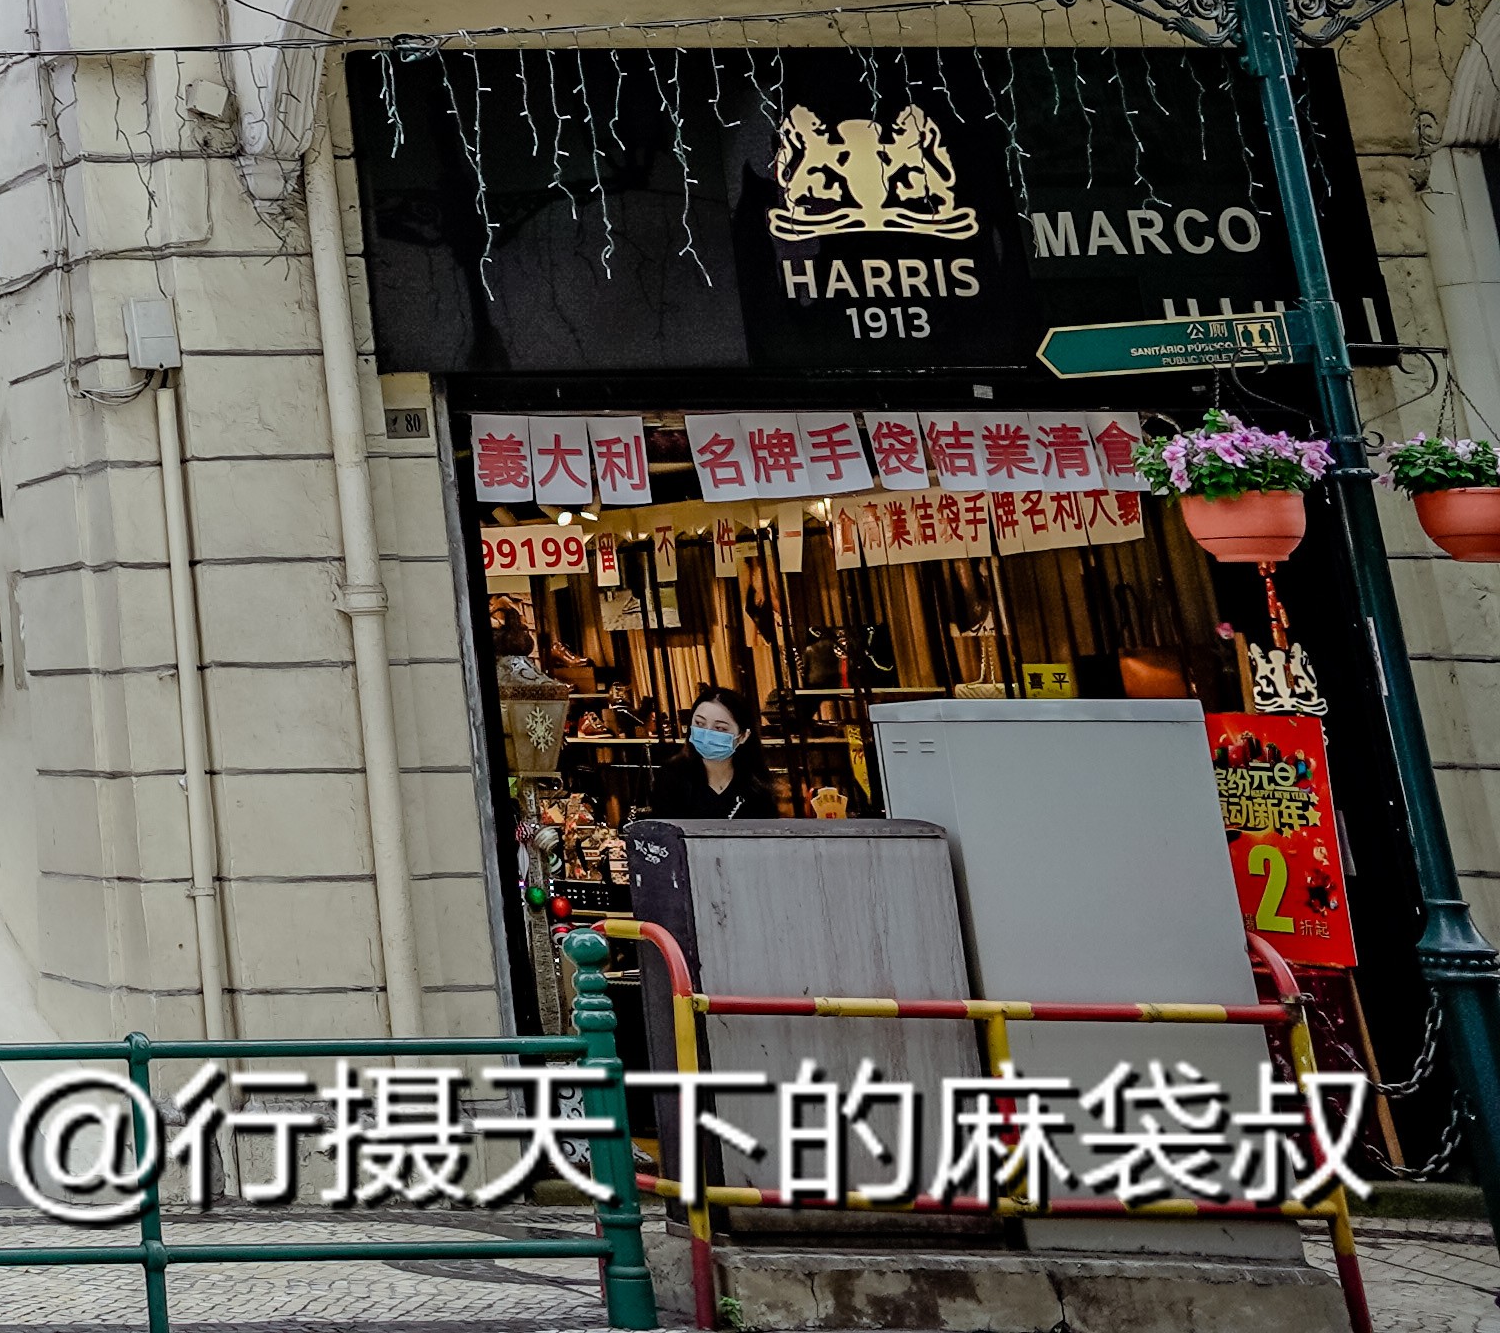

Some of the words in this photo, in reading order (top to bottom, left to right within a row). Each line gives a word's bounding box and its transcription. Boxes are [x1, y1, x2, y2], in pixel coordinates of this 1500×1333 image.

[1030, 207, 1261, 259] MARCO
[782, 258, 981, 299] HARRIS
[845, 307, 931, 340] 1913
[1130, 343, 1186, 357] SANITÁRIO
[1162, 354, 1199, 366] PUBLIC
[404, 413, 421, 434] 80
[477, 432, 648, 492] 義大利
[1247, 844, 1296, 935] 2
